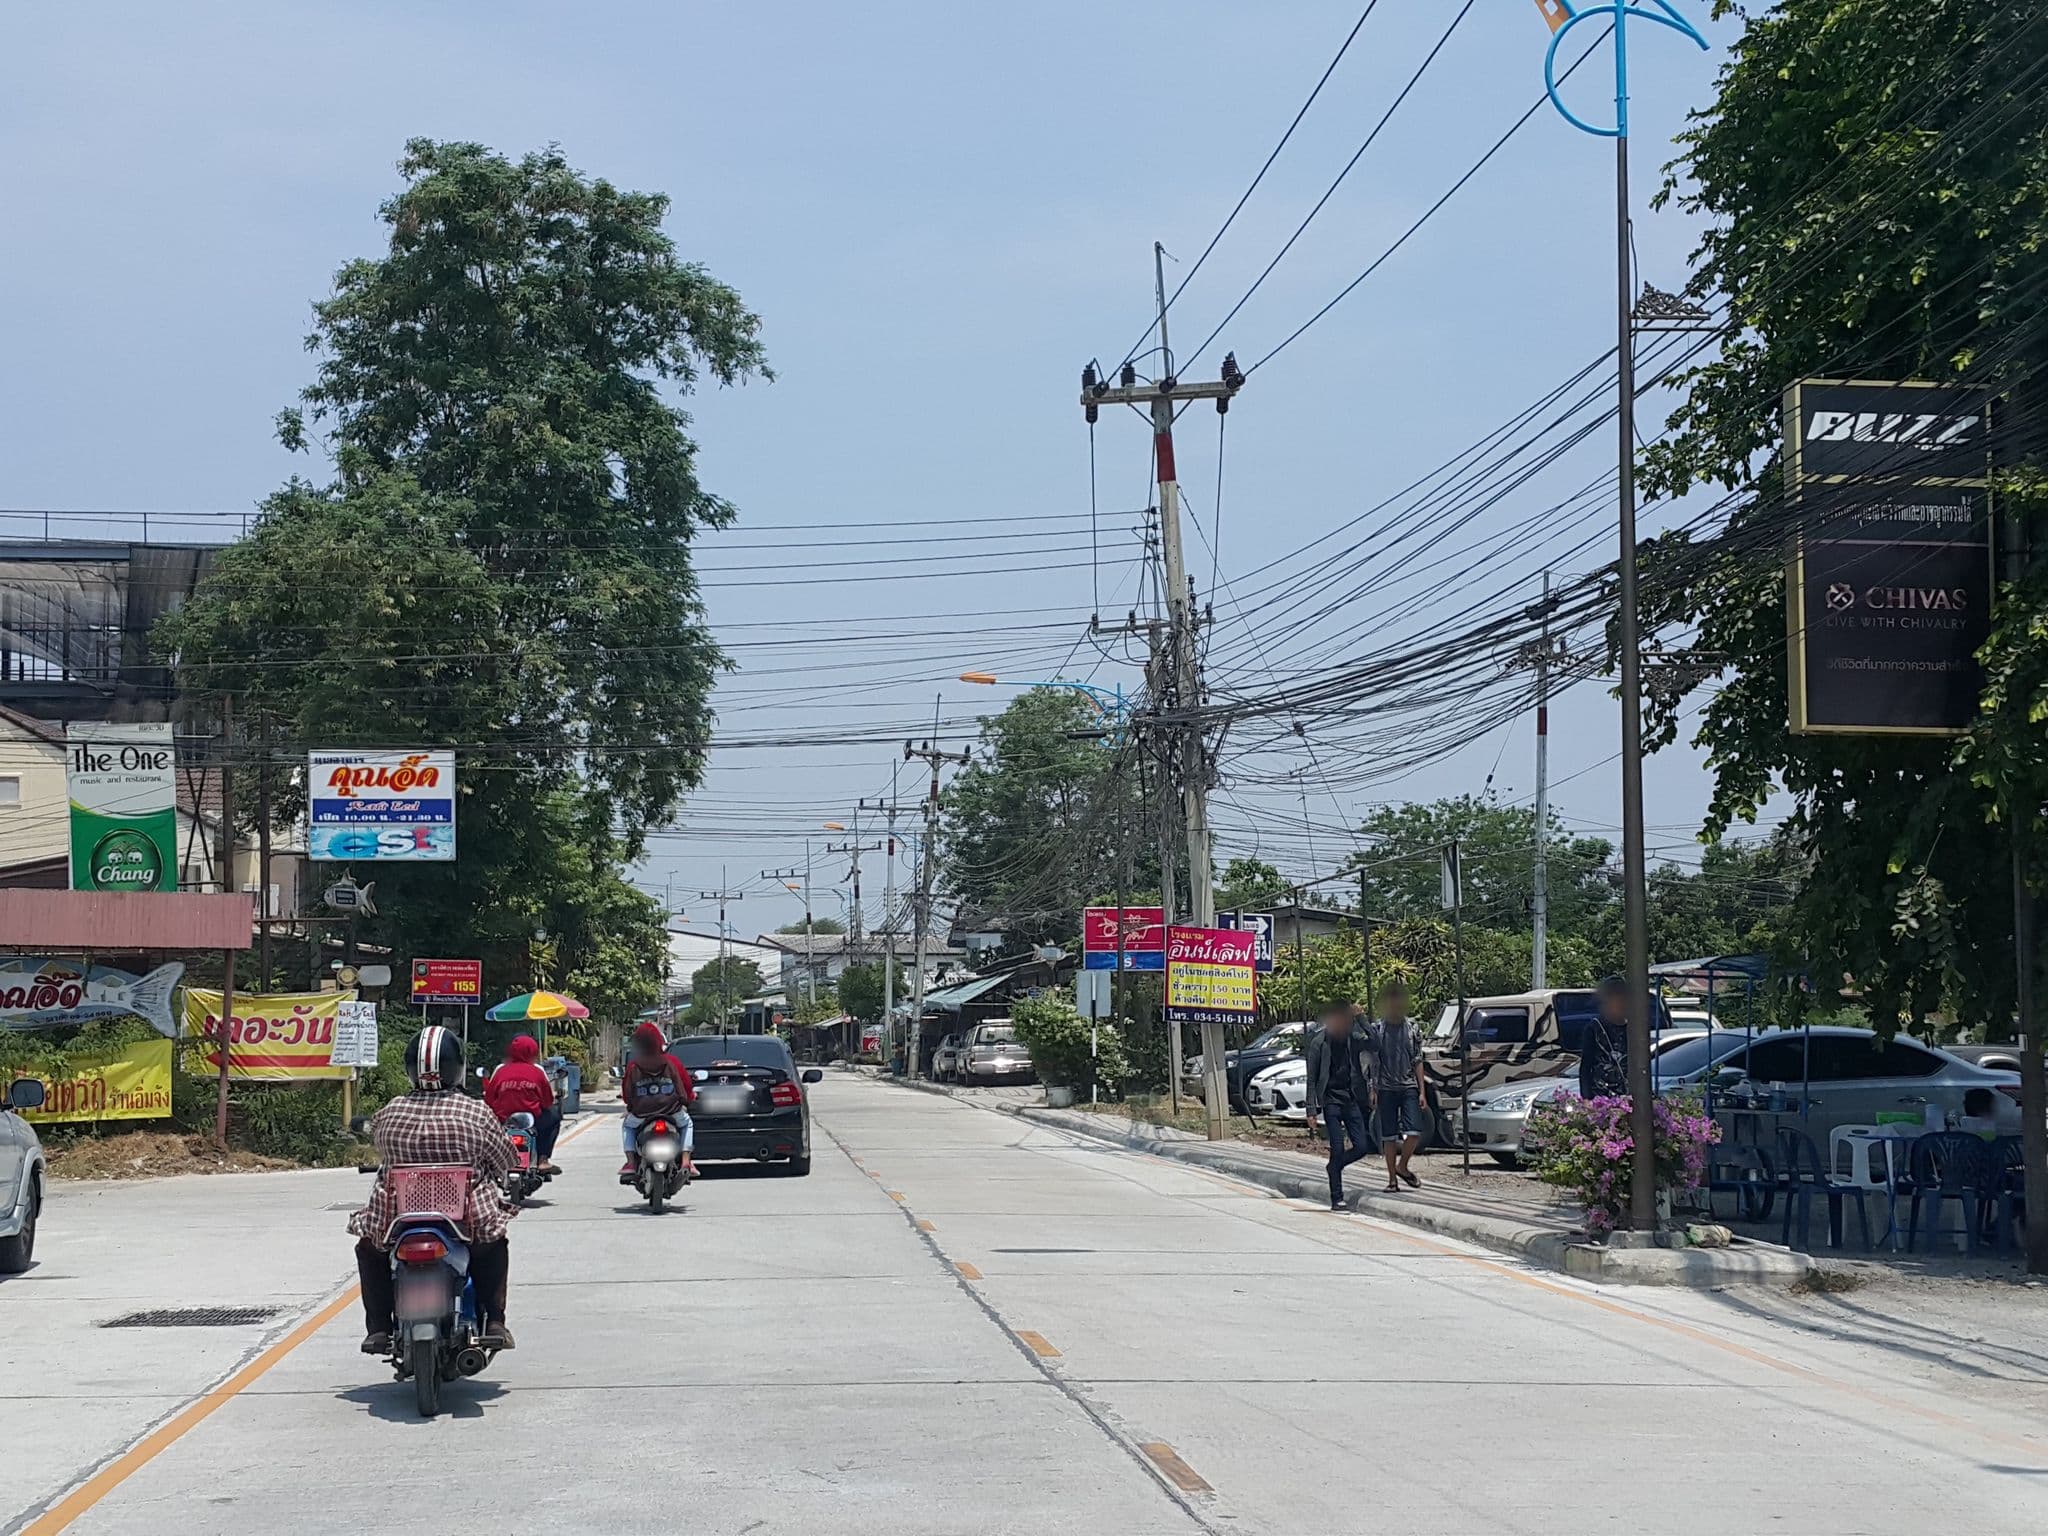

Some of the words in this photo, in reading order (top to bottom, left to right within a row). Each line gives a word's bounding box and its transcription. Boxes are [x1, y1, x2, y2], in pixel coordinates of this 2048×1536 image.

[1806, 411, 1980, 444] BUZZ
[1865, 587, 1968, 610] CHIVAS
[1826, 616, 1857, 628] LIVE
[1860, 616, 1896, 628] WITH
[1899, 616, 1968, 630] CHIVALRY
[74, 741, 113, 773] The
[120, 746, 169, 771] One
[80, 776, 102, 785] music
[106, 775, 122, 784] and
[97, 865, 155, 886] Chang
[453, 980, 476, 992] 1155
[1212, 984, 1228, 993] 150
[1231, 986, 1251, 995] บาท
[1231, 999, 1251, 1008] บาท
[1193, 1012, 1255, 1025] 034-516-118
